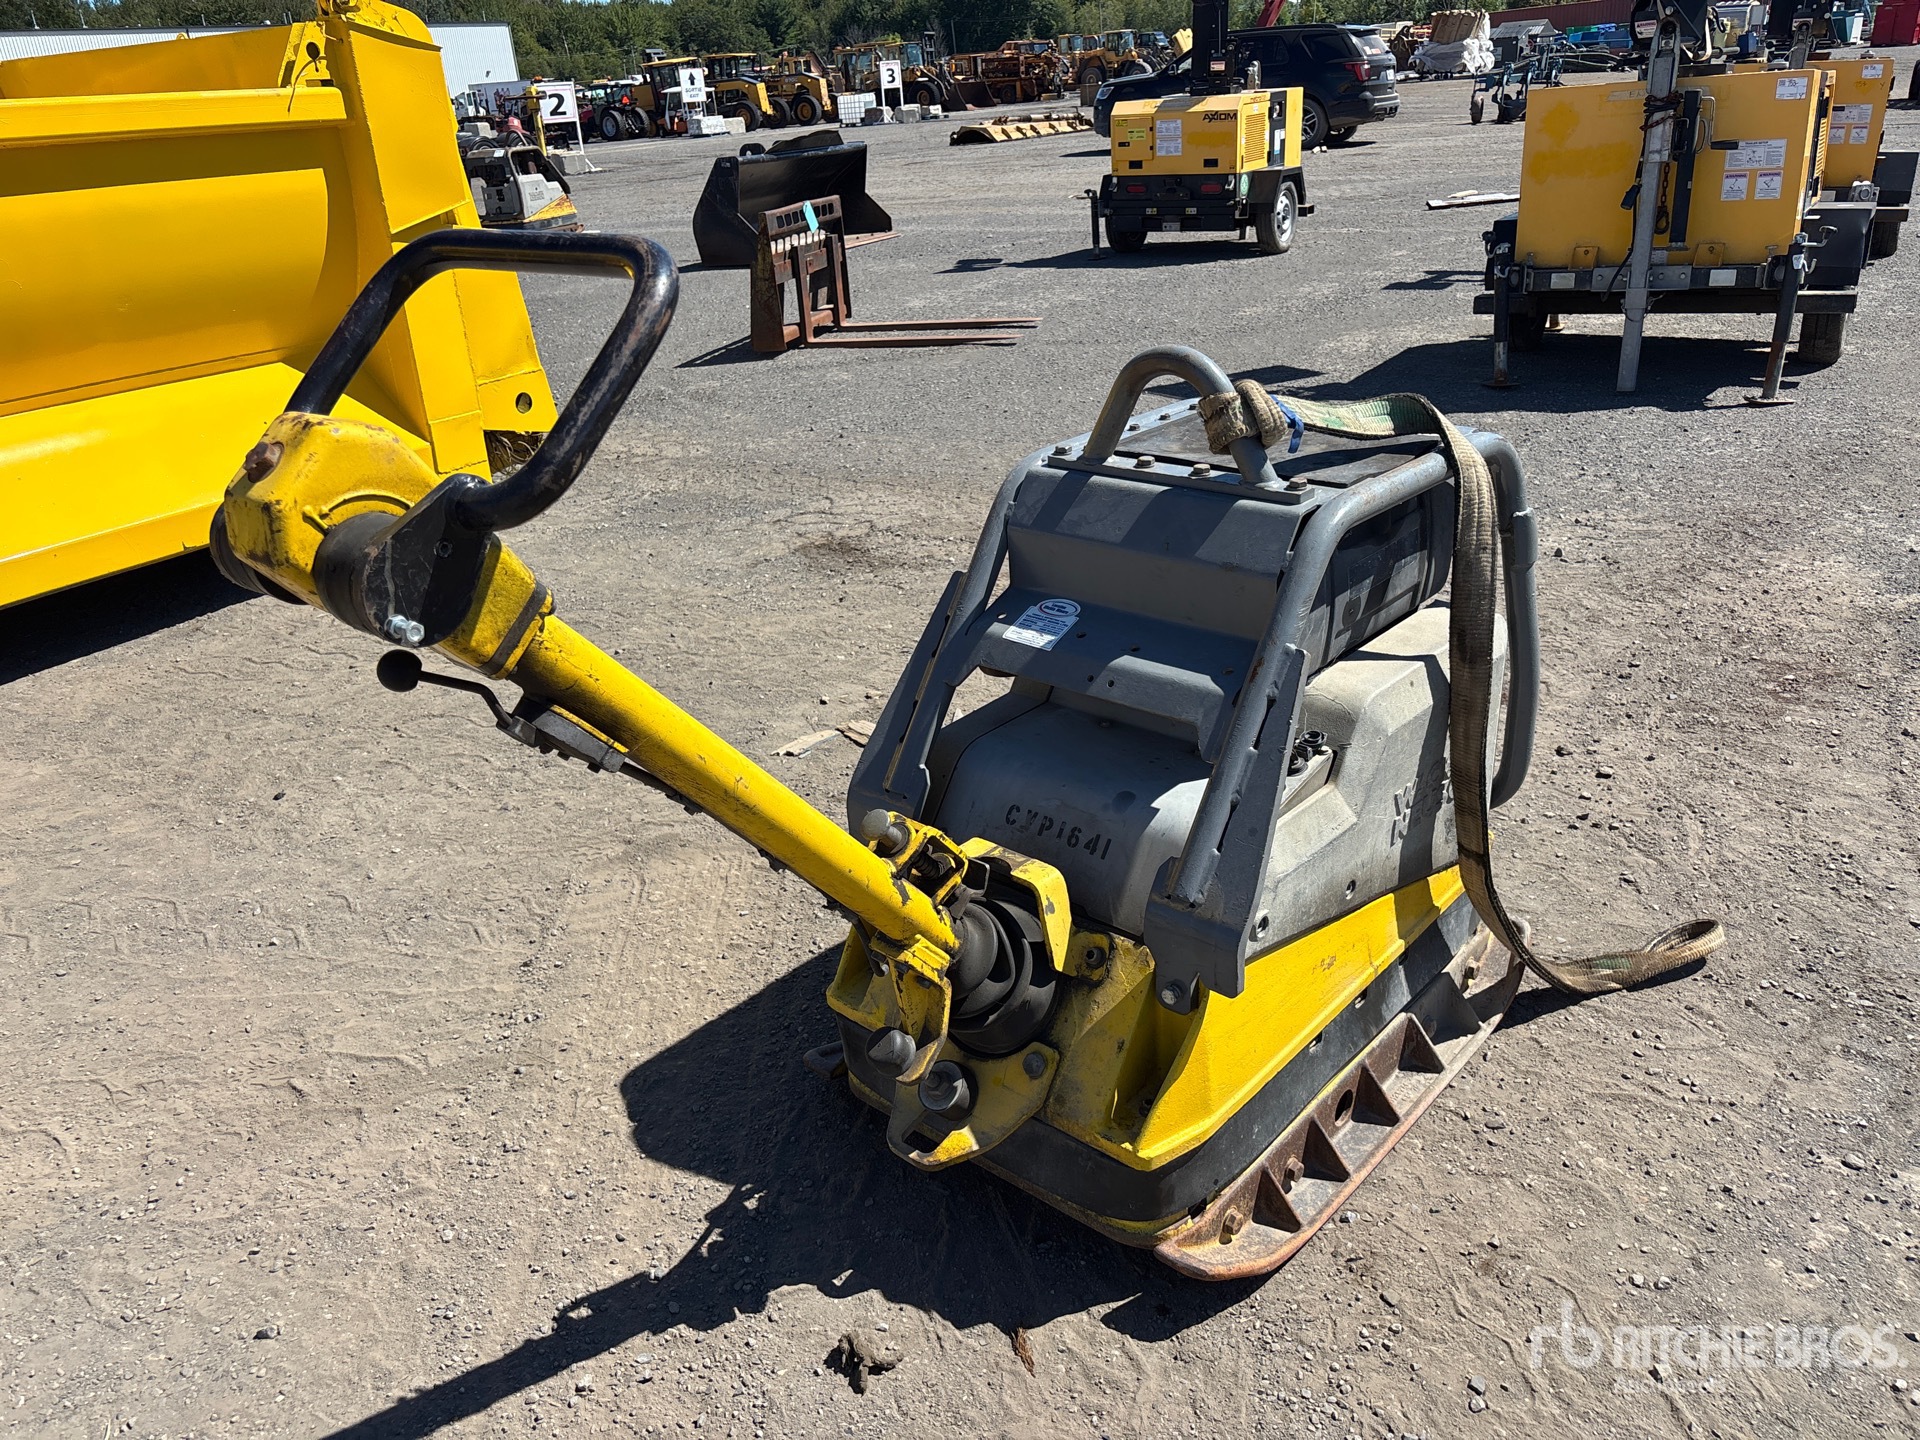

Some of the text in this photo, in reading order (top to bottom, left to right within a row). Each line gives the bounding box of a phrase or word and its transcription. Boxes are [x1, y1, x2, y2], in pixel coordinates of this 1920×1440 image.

[886, 68, 896, 83] 3
[548, 93, 567, 116] 2
[1202, 110, 1237, 123] AXIOM
